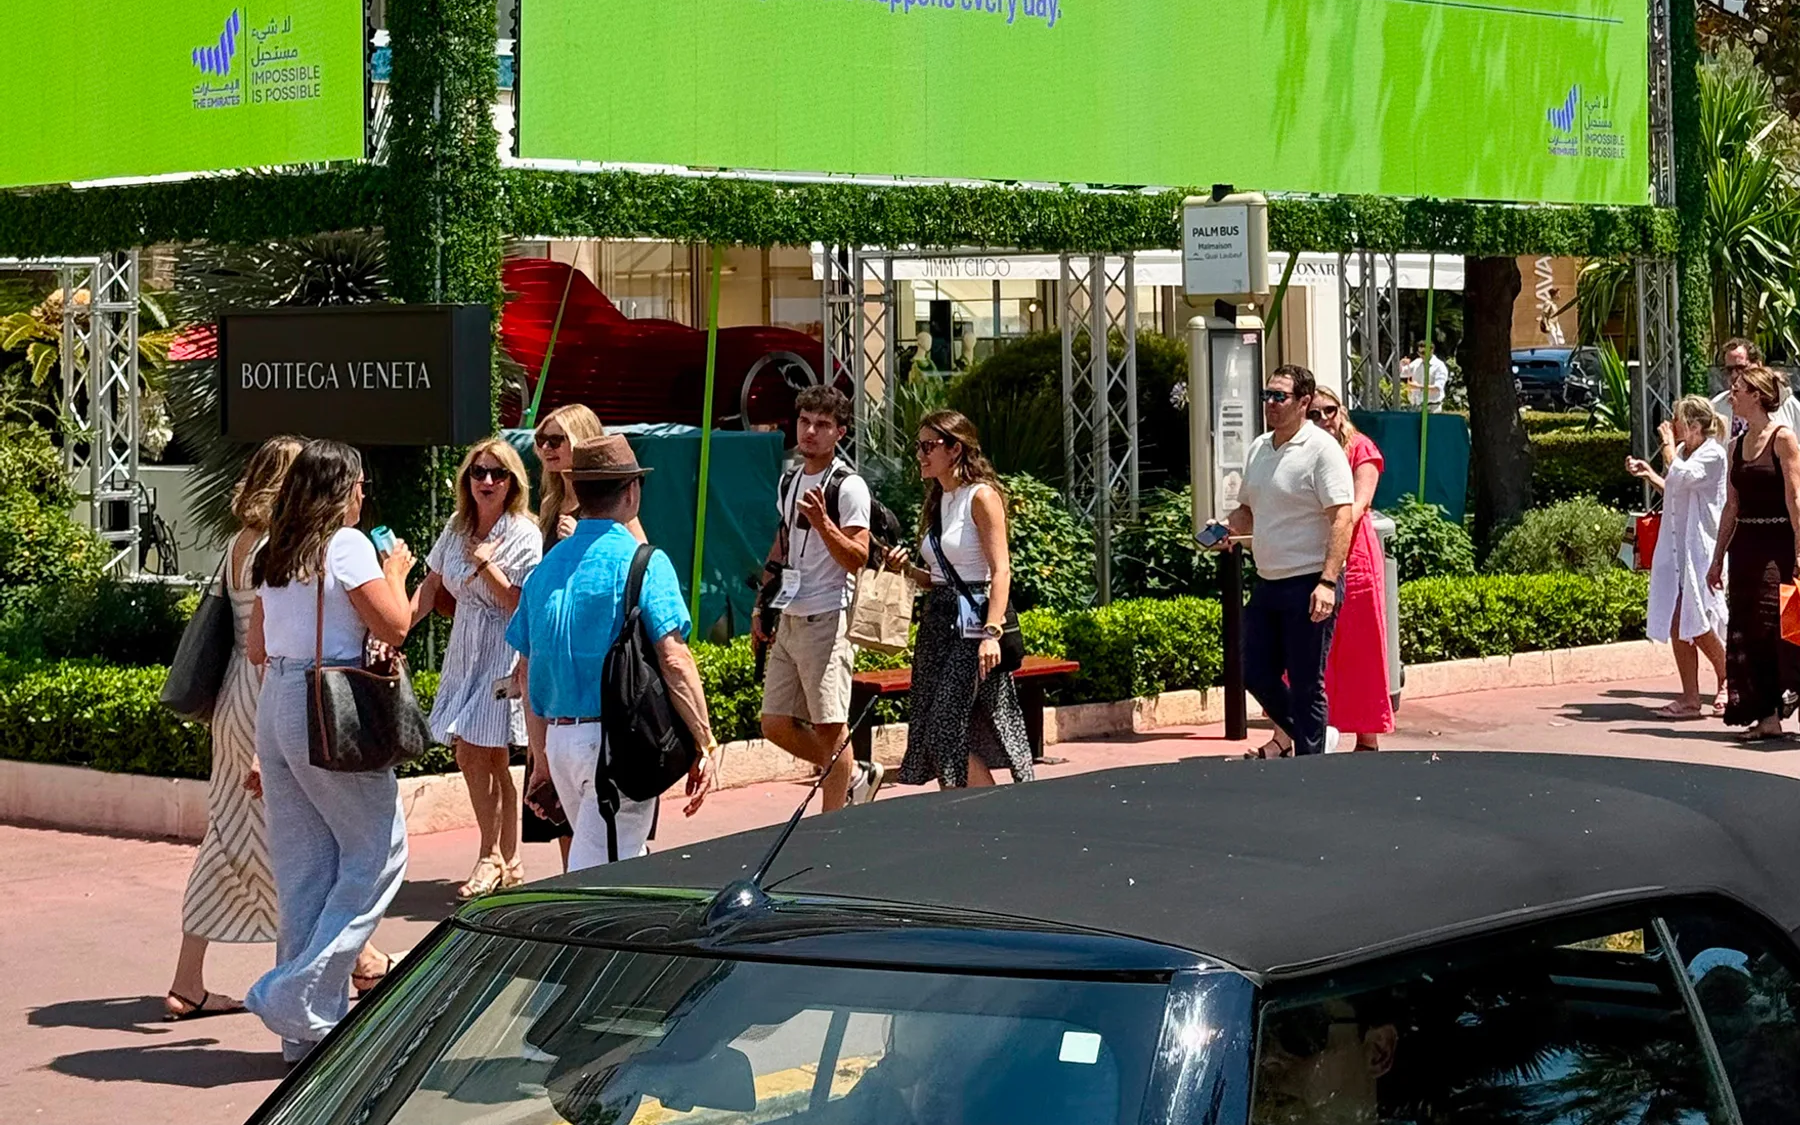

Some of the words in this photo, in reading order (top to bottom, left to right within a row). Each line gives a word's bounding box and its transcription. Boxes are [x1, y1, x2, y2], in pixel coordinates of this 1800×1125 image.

[251, 65, 320, 85] IMPOSSIBLE
[251, 89, 262, 104] IS
[265, 83, 321, 102] POSSIBLE
[1192, 226, 1219, 237] PALM
[1219, 225, 1240, 237] BUS
[921, 257, 960, 277] JIMMY
[964, 258, 1011, 277] CHOO
[241, 362, 340, 390] BOTTEGA
[347, 361, 432, 389] VENETA
